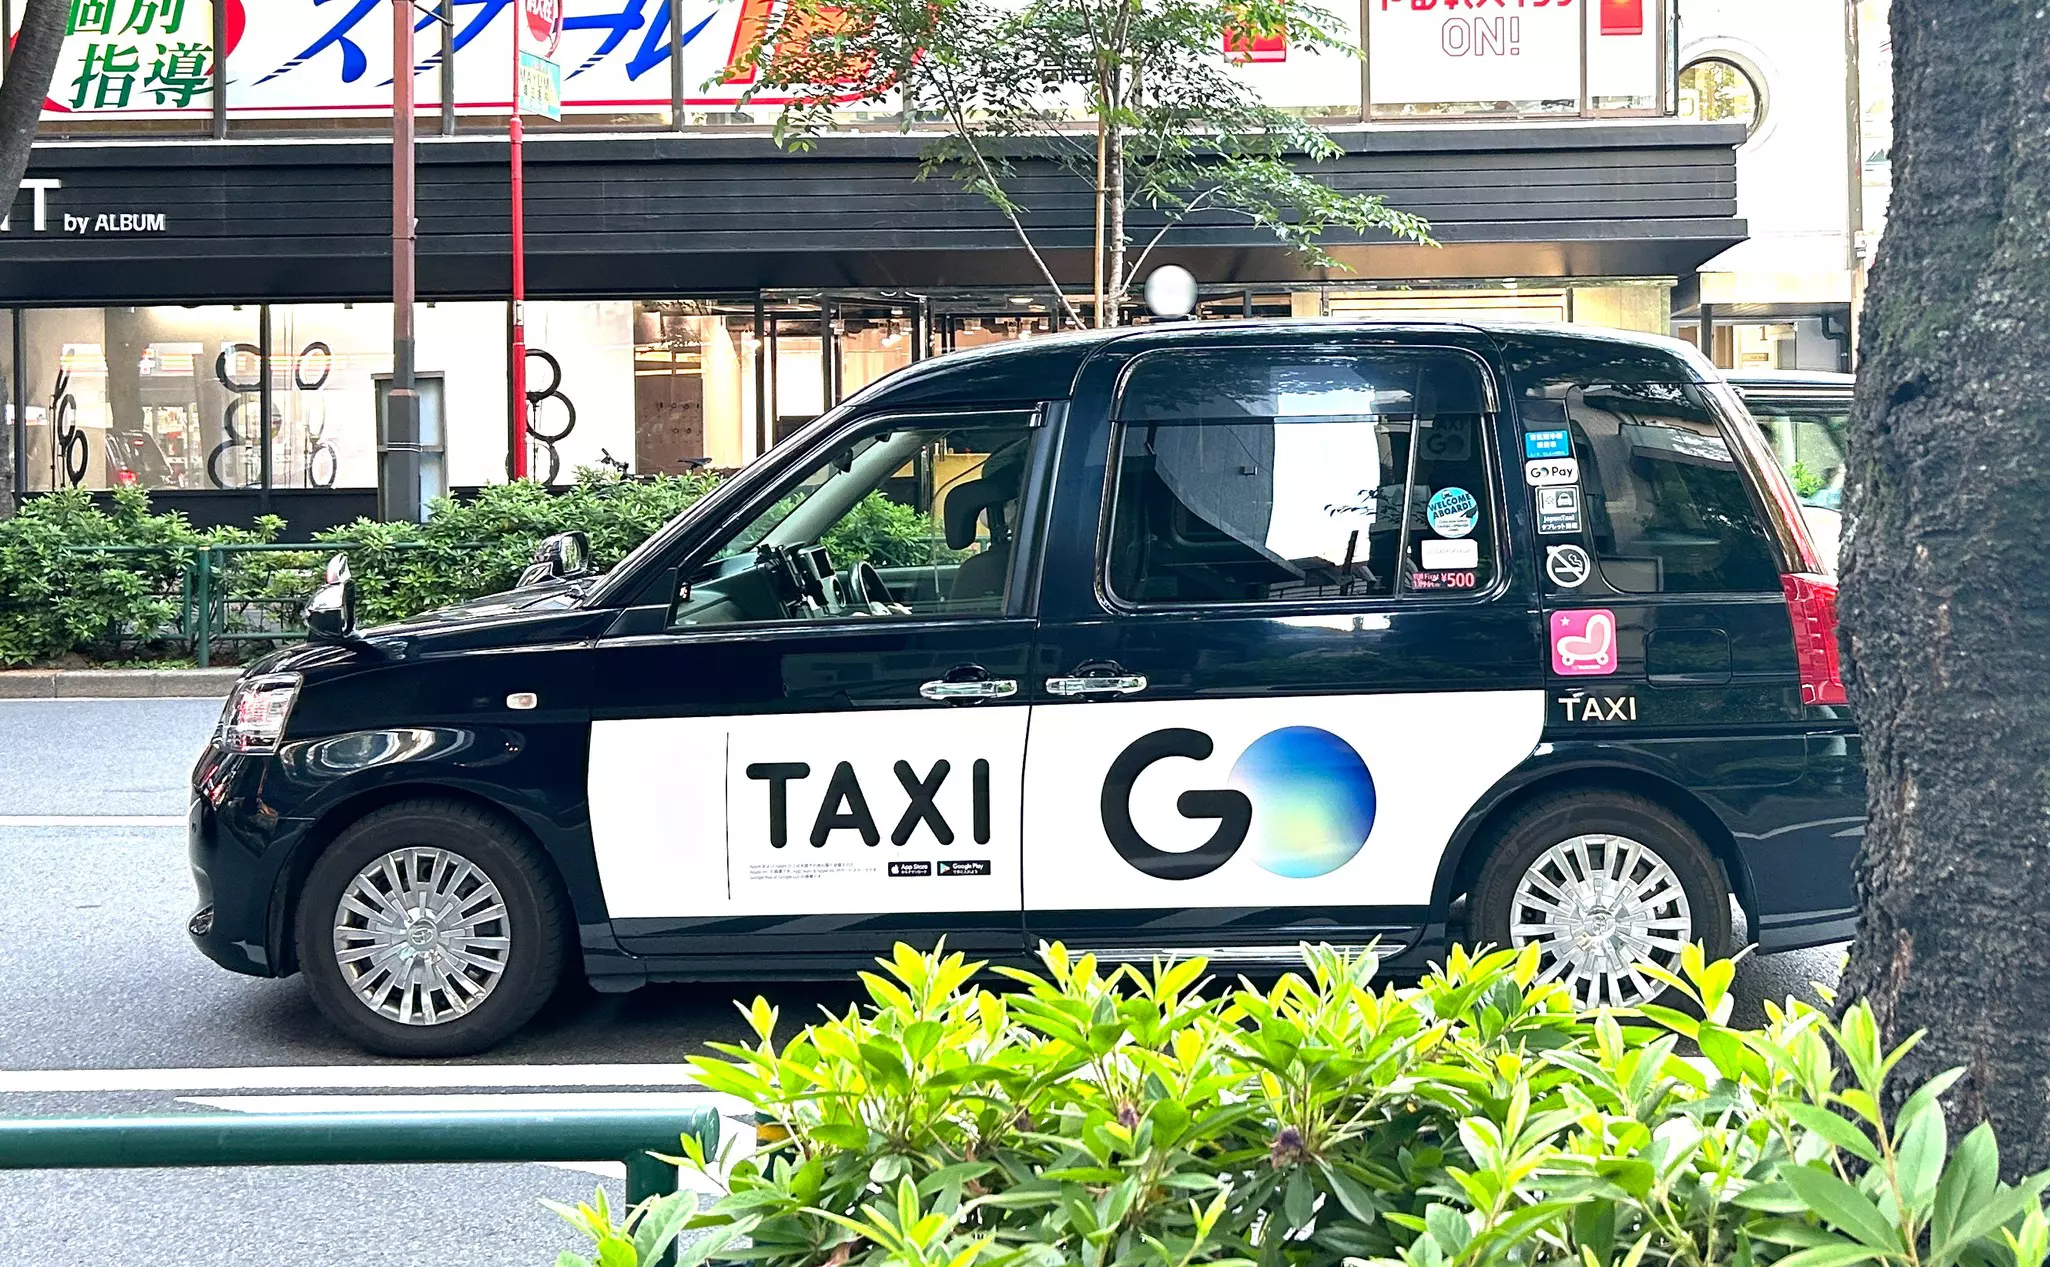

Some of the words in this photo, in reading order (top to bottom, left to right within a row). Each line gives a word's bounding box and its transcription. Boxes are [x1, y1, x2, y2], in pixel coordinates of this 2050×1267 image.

[1441, 16, 1520, 57] ON!
[68, 42, 213, 108] 指導
[64, 213, 89, 234] by
[94, 213, 166, 232] ALBUM
[1551, 466, 1573, 478] Pay
[1428, 493, 1472, 512] WELCOME
[1432, 502, 1473, 520] ABOARD!
[1441, 572, 1475, 587] ¥500
[1558, 697, 1637, 721] TAXI
[746, 758, 991, 849] TAXI
[1100, 725, 1377, 880] GO
